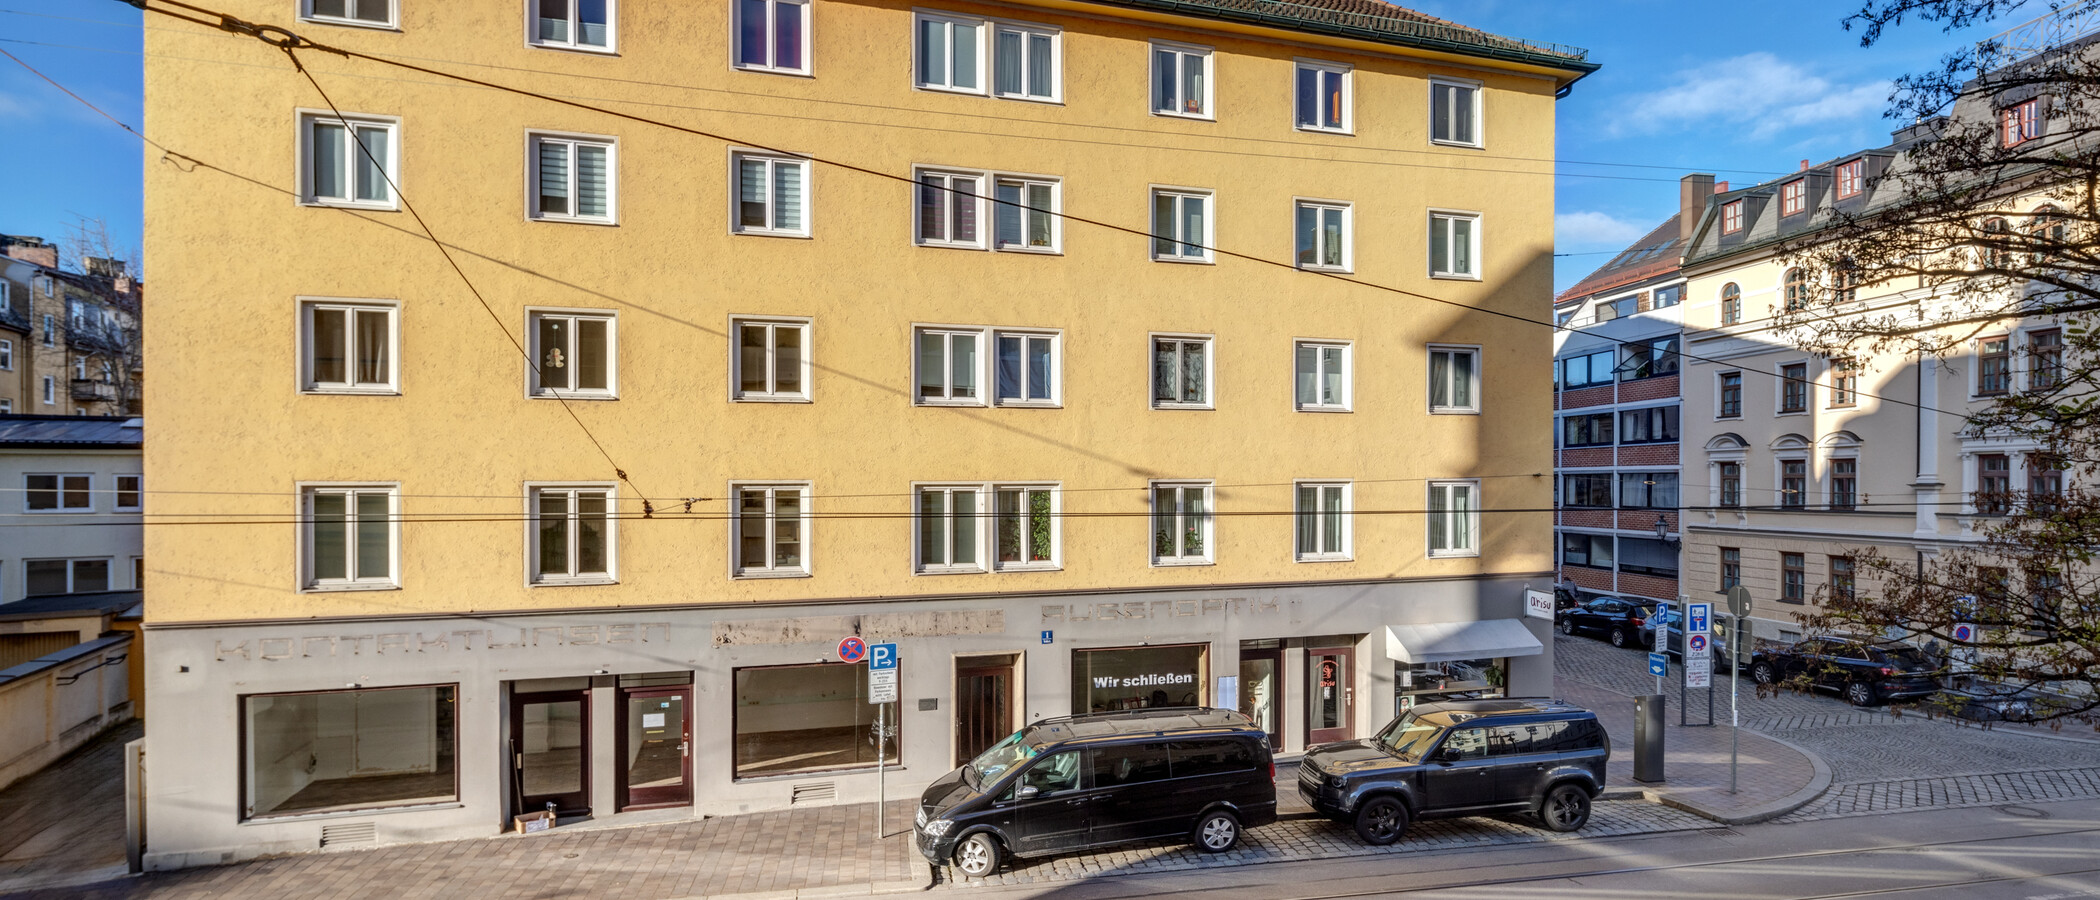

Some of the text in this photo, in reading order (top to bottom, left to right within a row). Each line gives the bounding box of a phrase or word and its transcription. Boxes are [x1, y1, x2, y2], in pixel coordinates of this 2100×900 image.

[1531, 596, 1551, 609] arisu
[1659, 606, 1665, 622] P
[874, 646, 889, 667] P
[1093, 673, 1193, 689] Wir schließen
